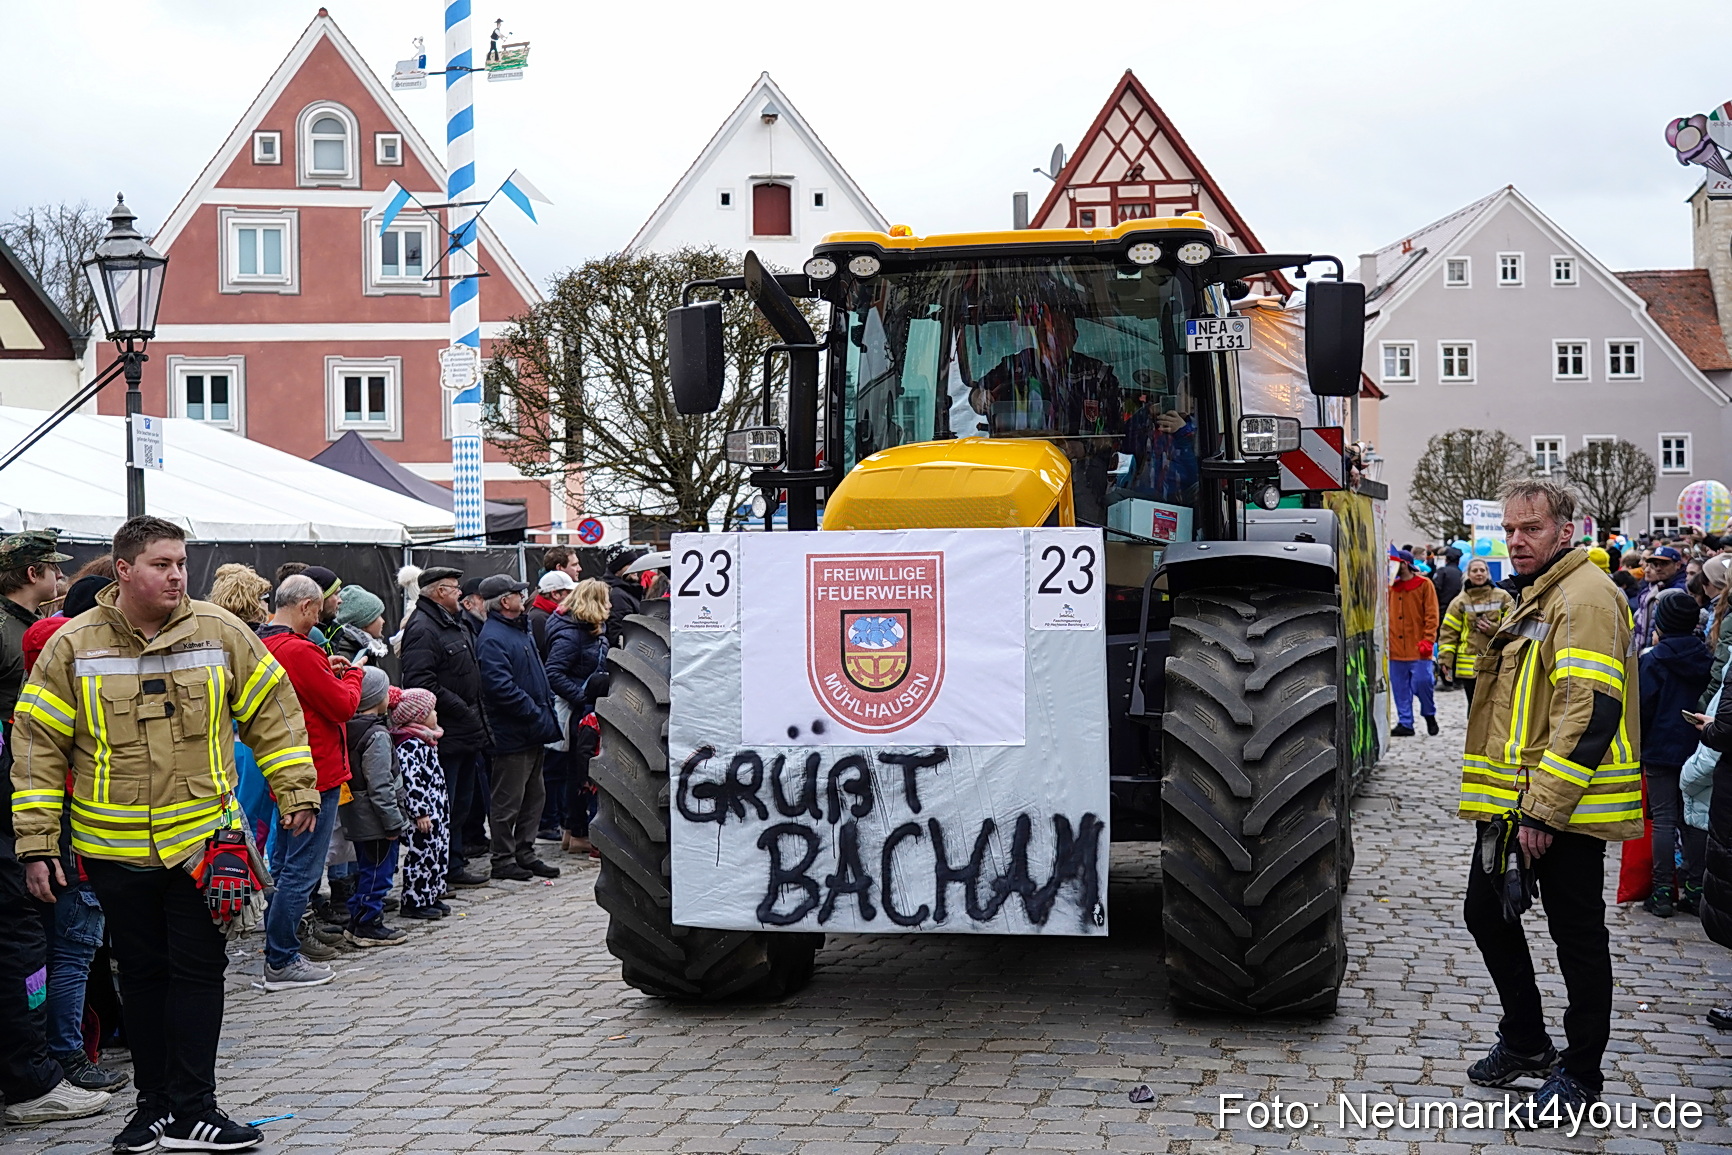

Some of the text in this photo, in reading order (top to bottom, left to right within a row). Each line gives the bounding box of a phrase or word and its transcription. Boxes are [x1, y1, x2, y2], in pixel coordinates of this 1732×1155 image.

[1198, 321, 1228, 335] NEA
[1465, 504, 1479, 516] 25
[677, 549, 732, 598] 23
[823, 566, 927, 582] FREIWILLIGE
[1037, 545, 1096, 595] 23
[817, 584, 934, 601] FEUERWEHR
[823, 672, 930, 719] MÜHLHAUSEN
